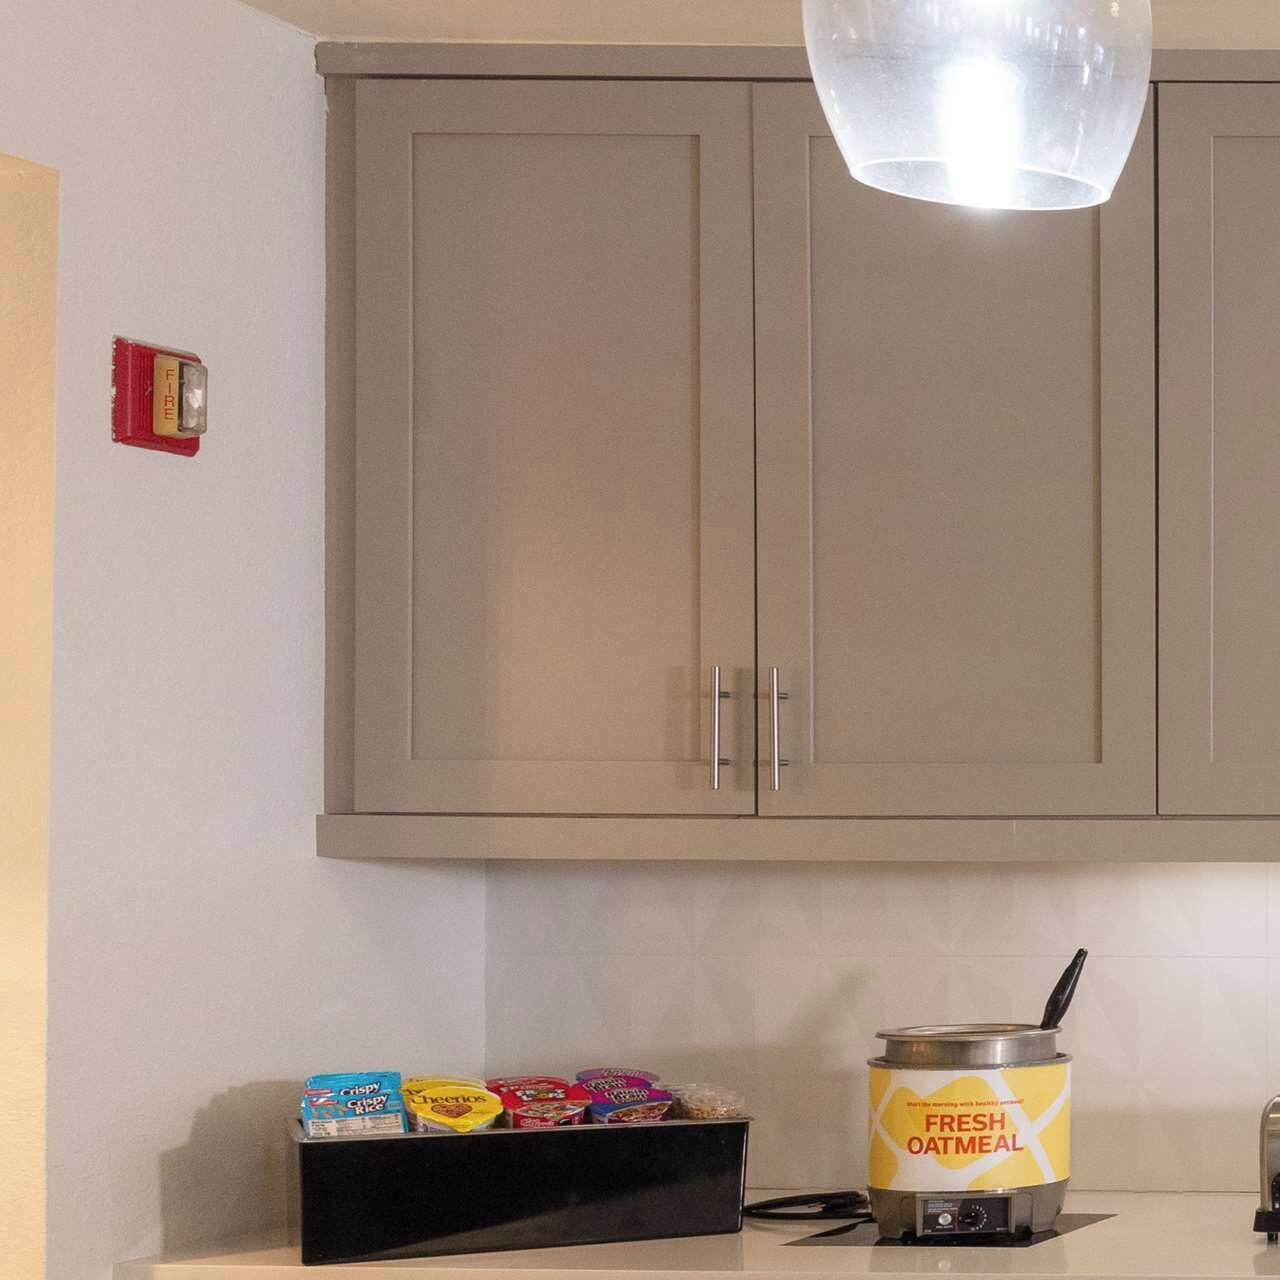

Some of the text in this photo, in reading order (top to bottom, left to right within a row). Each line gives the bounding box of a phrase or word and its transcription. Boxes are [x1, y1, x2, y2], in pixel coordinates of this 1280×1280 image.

[164, 369, 175, 420] FIRE
[340, 1082, 380, 1096] Crispy
[347, 1094, 388, 1108] Crispy
[411, 1092, 487, 1105] Cheerios
[355, 1104, 384, 1115] Rice
[925, 1112, 1006, 1133] FRESH
[907, 1133, 1024, 1155] OATMEAL
